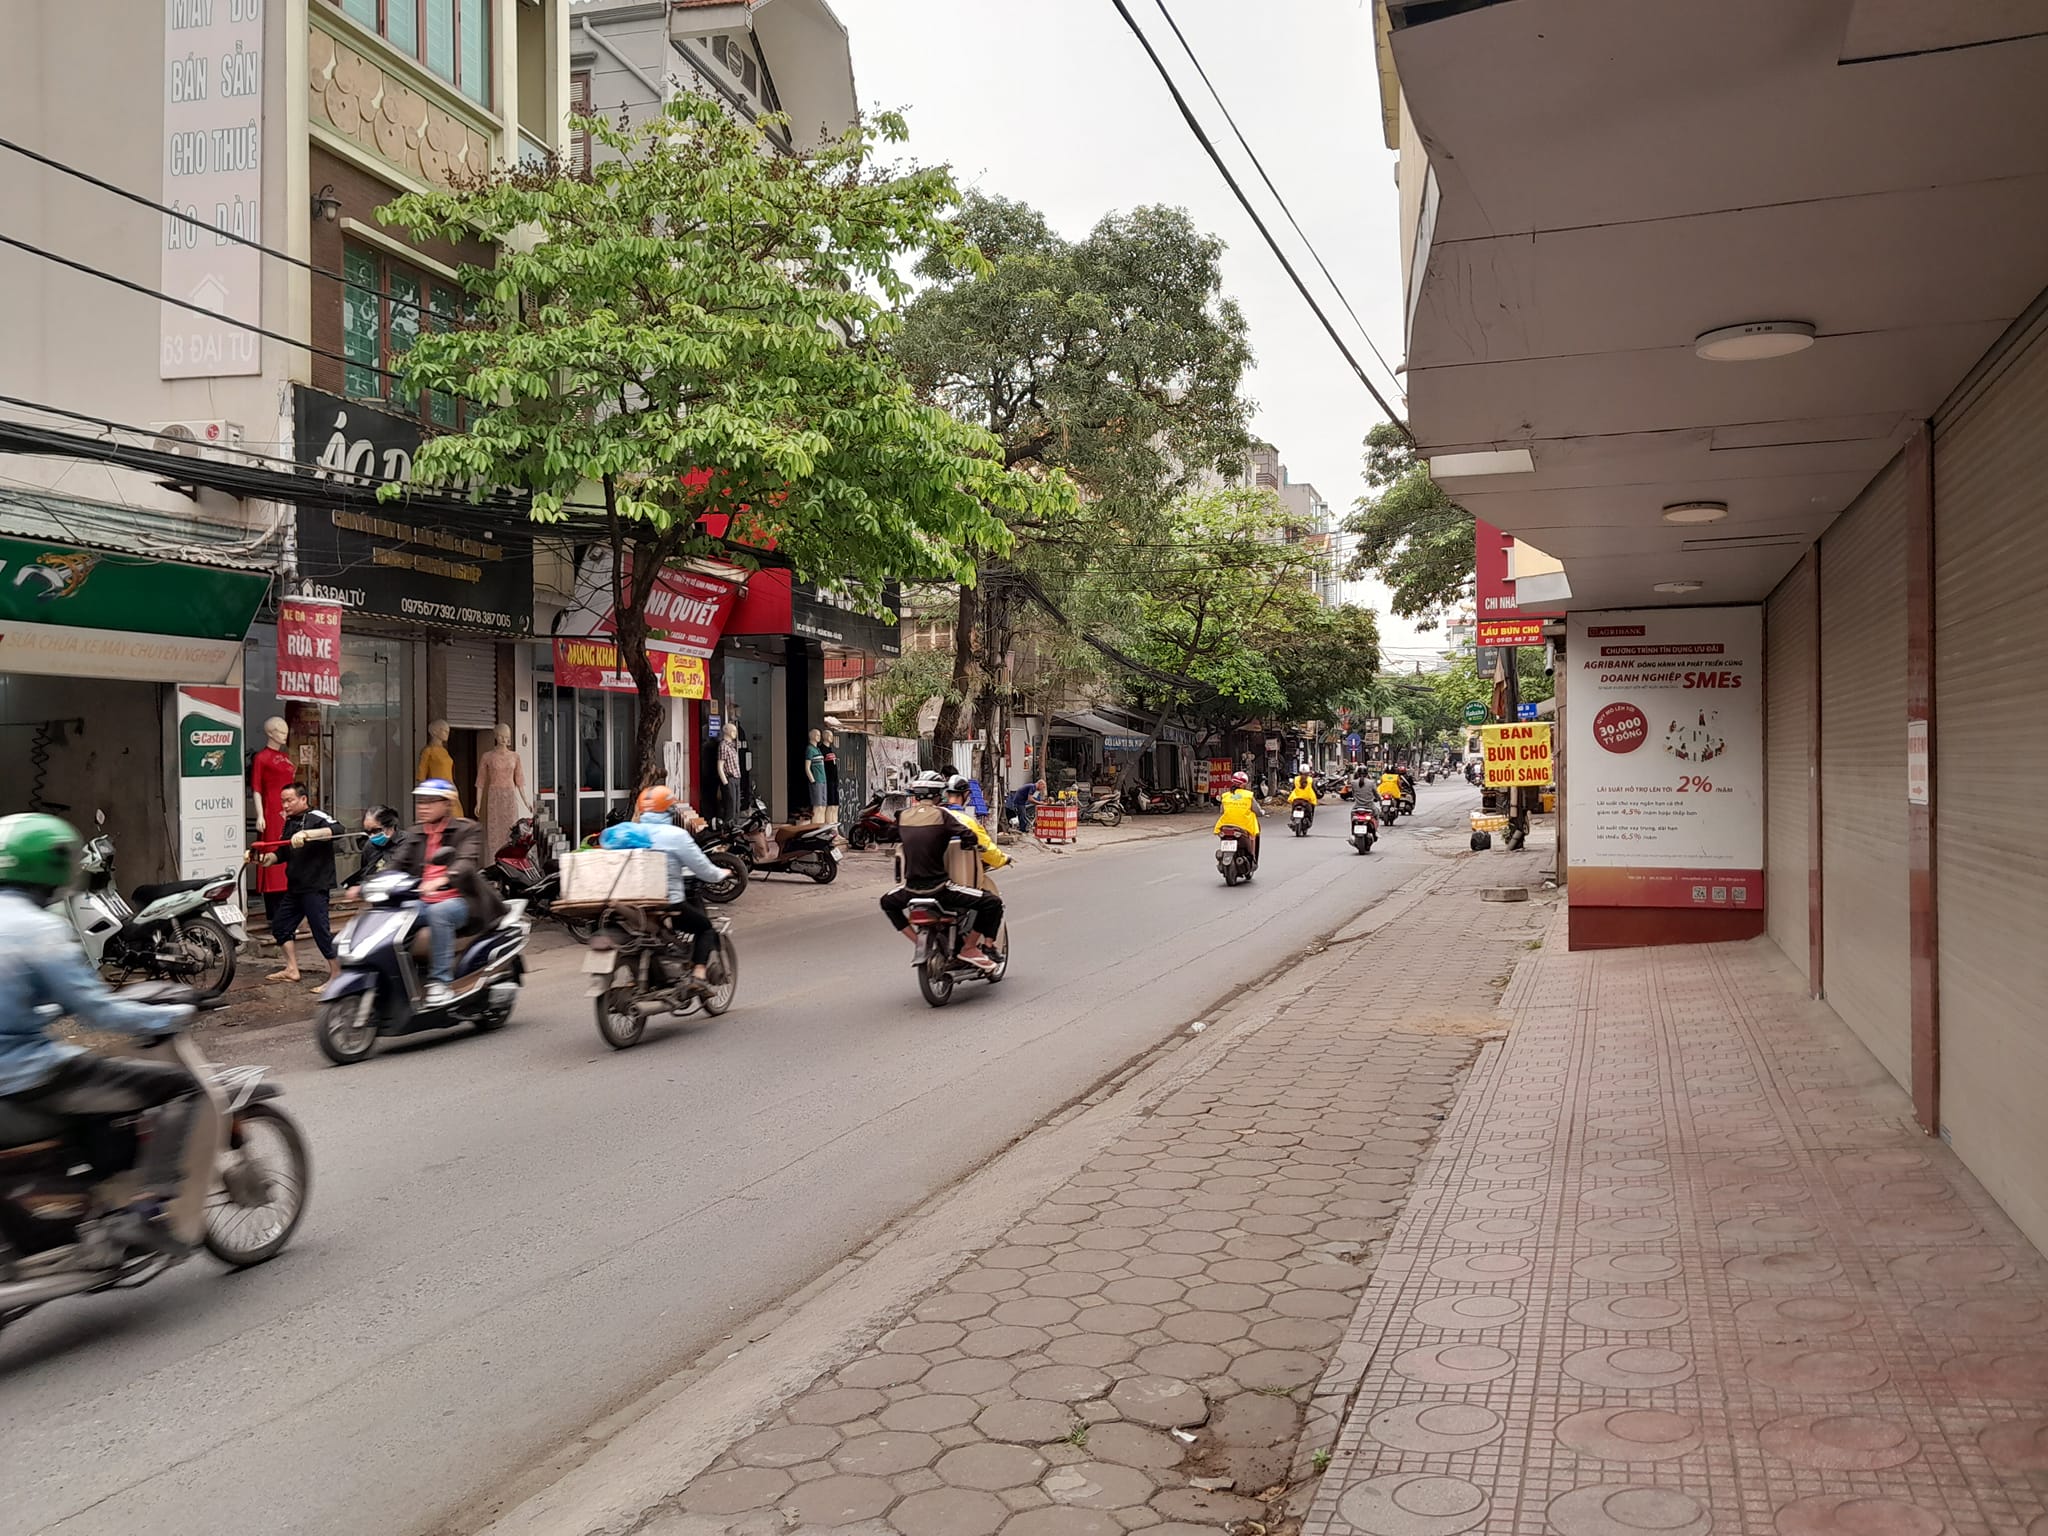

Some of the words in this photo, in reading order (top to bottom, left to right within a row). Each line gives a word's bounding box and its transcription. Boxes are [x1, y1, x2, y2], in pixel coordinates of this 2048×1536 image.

[172, 52, 208, 103] BÁN
[170, 130, 207, 176] CHO
[212, 118, 257, 173] THUÊ
[168, 200, 198, 249] ÁO
[216, 195, 256, 247] DÀI
[163, 336, 183, 366] 63
[315, 585, 328, 599] 63
[644, 589, 671, 617] NH
[669, 596, 719, 627] QUYẾT
[1485, 597, 1497, 610] CHI
[1499, 596, 1517, 610] NHÁ
[283, 609, 294, 621] XE
[315, 613, 325, 625] XE
[1599, 628, 1642, 636] AGRIBANK
[80, 639, 100, 653] XE
[287, 629, 313, 657] RỬA
[316, 638, 332, 659] XE
[1606, 647, 1636, 655] CHƯƠNG
[1583, 660, 1635, 669] AGRIBANK
[280, 670, 311, 693] THAY
[1600, 674, 1640, 682] DOANH
[1641, 671, 1681, 683] NGHIỆP
[1682, 671, 1742, 689] SMEs
[1598, 717, 1641, 737] 30.000
[1615, 728, 1642, 742] ĐỒNG
[201, 733, 231, 744] Castrol
[1488, 743, 1516, 762] BÚN
[1520, 741, 1548, 761] CHÓ
[1488, 764, 1515, 783] BUỔI
[1518, 765, 1549, 781] SÁNG
[1676, 775, 1713, 793] 2%
[194, 796, 233, 811] CHUYÊN
